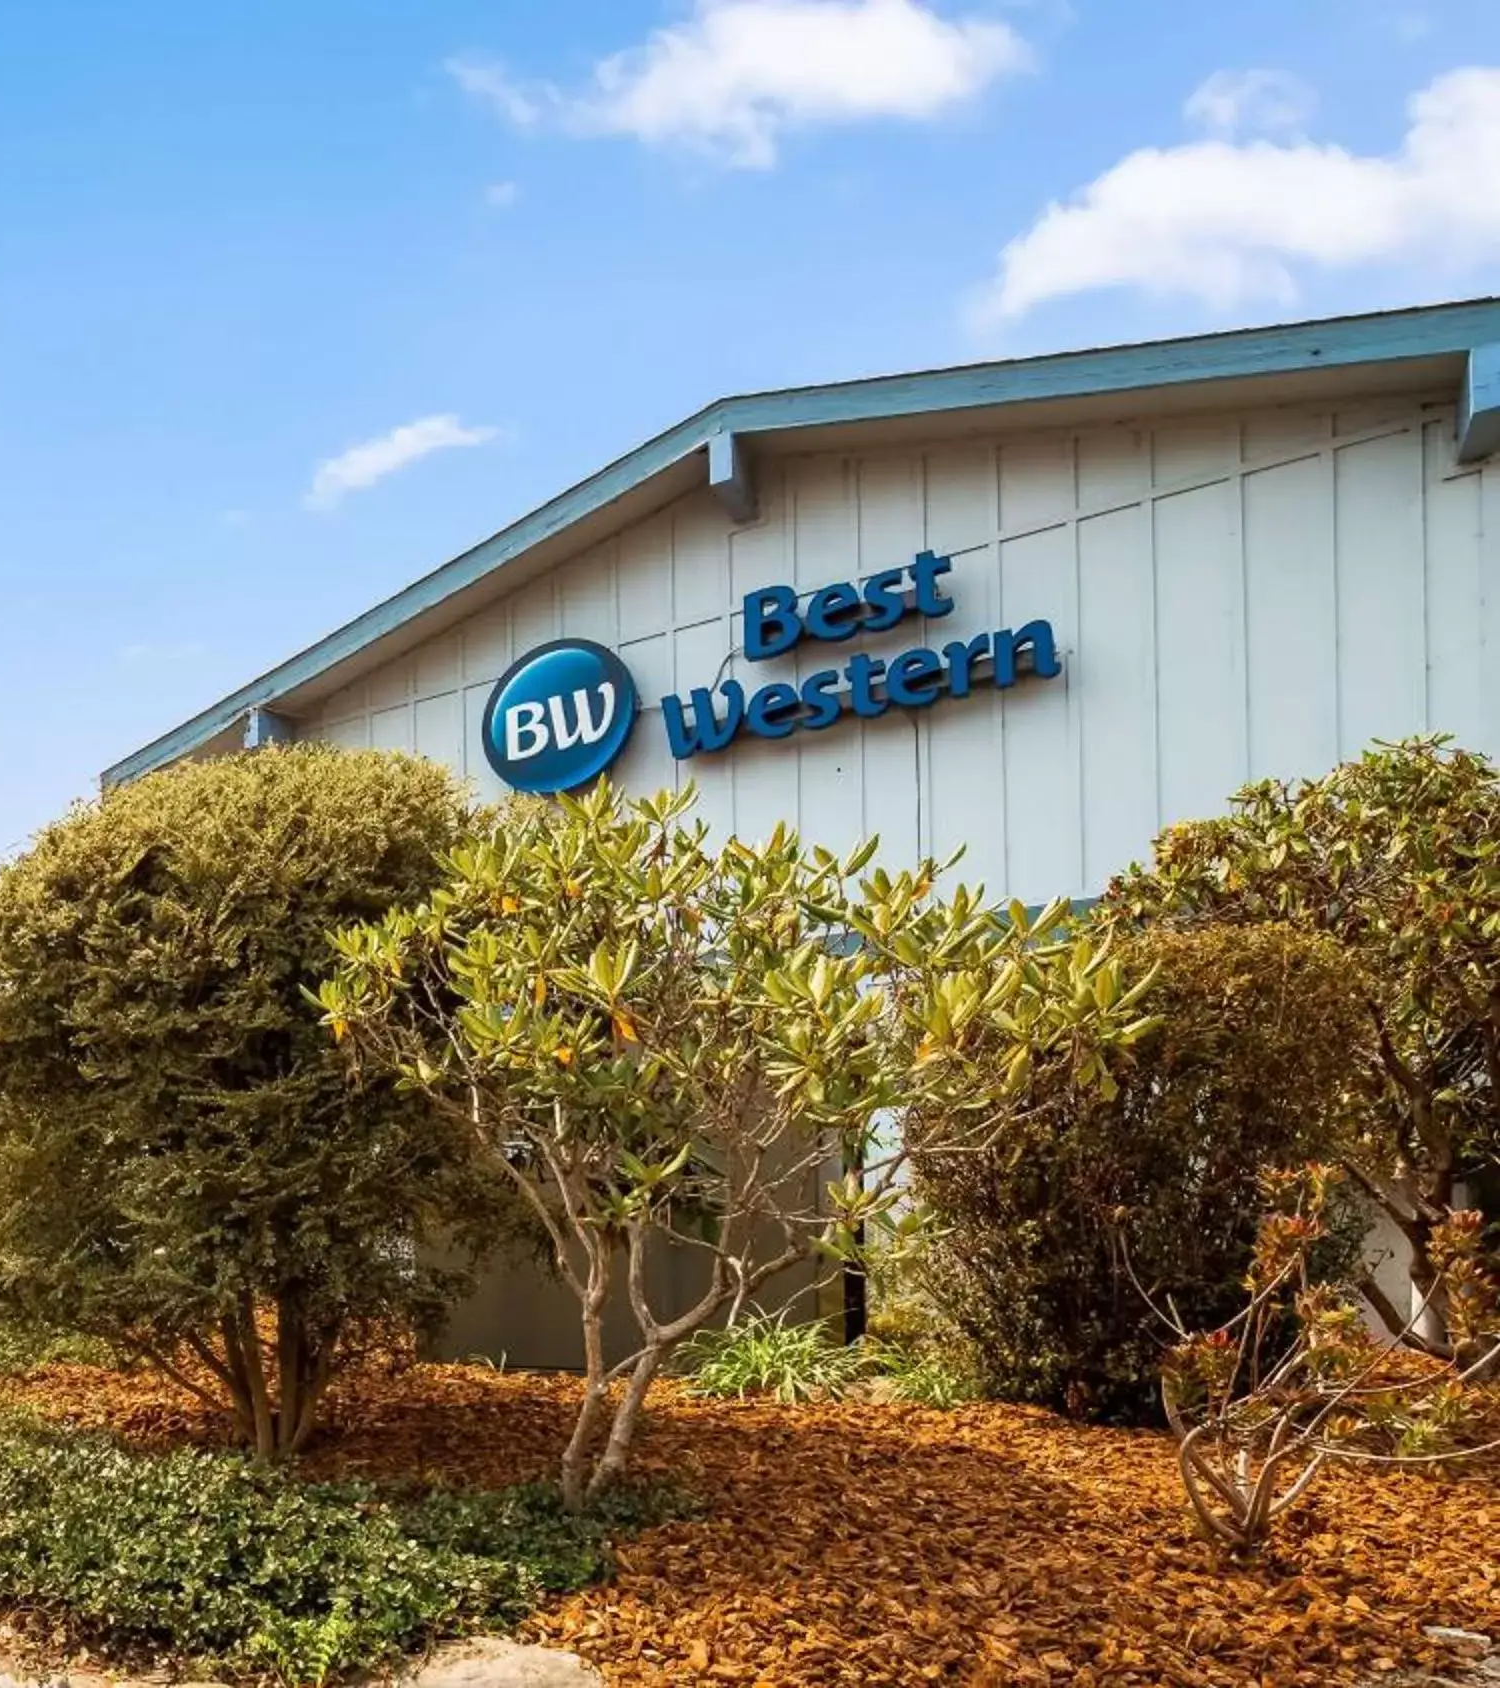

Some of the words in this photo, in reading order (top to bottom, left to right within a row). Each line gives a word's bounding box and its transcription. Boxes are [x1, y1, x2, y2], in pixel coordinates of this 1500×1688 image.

[743, 549, 955, 662] Best
[504, 681, 615, 761] BW
[661, 618, 1061, 760] Western
